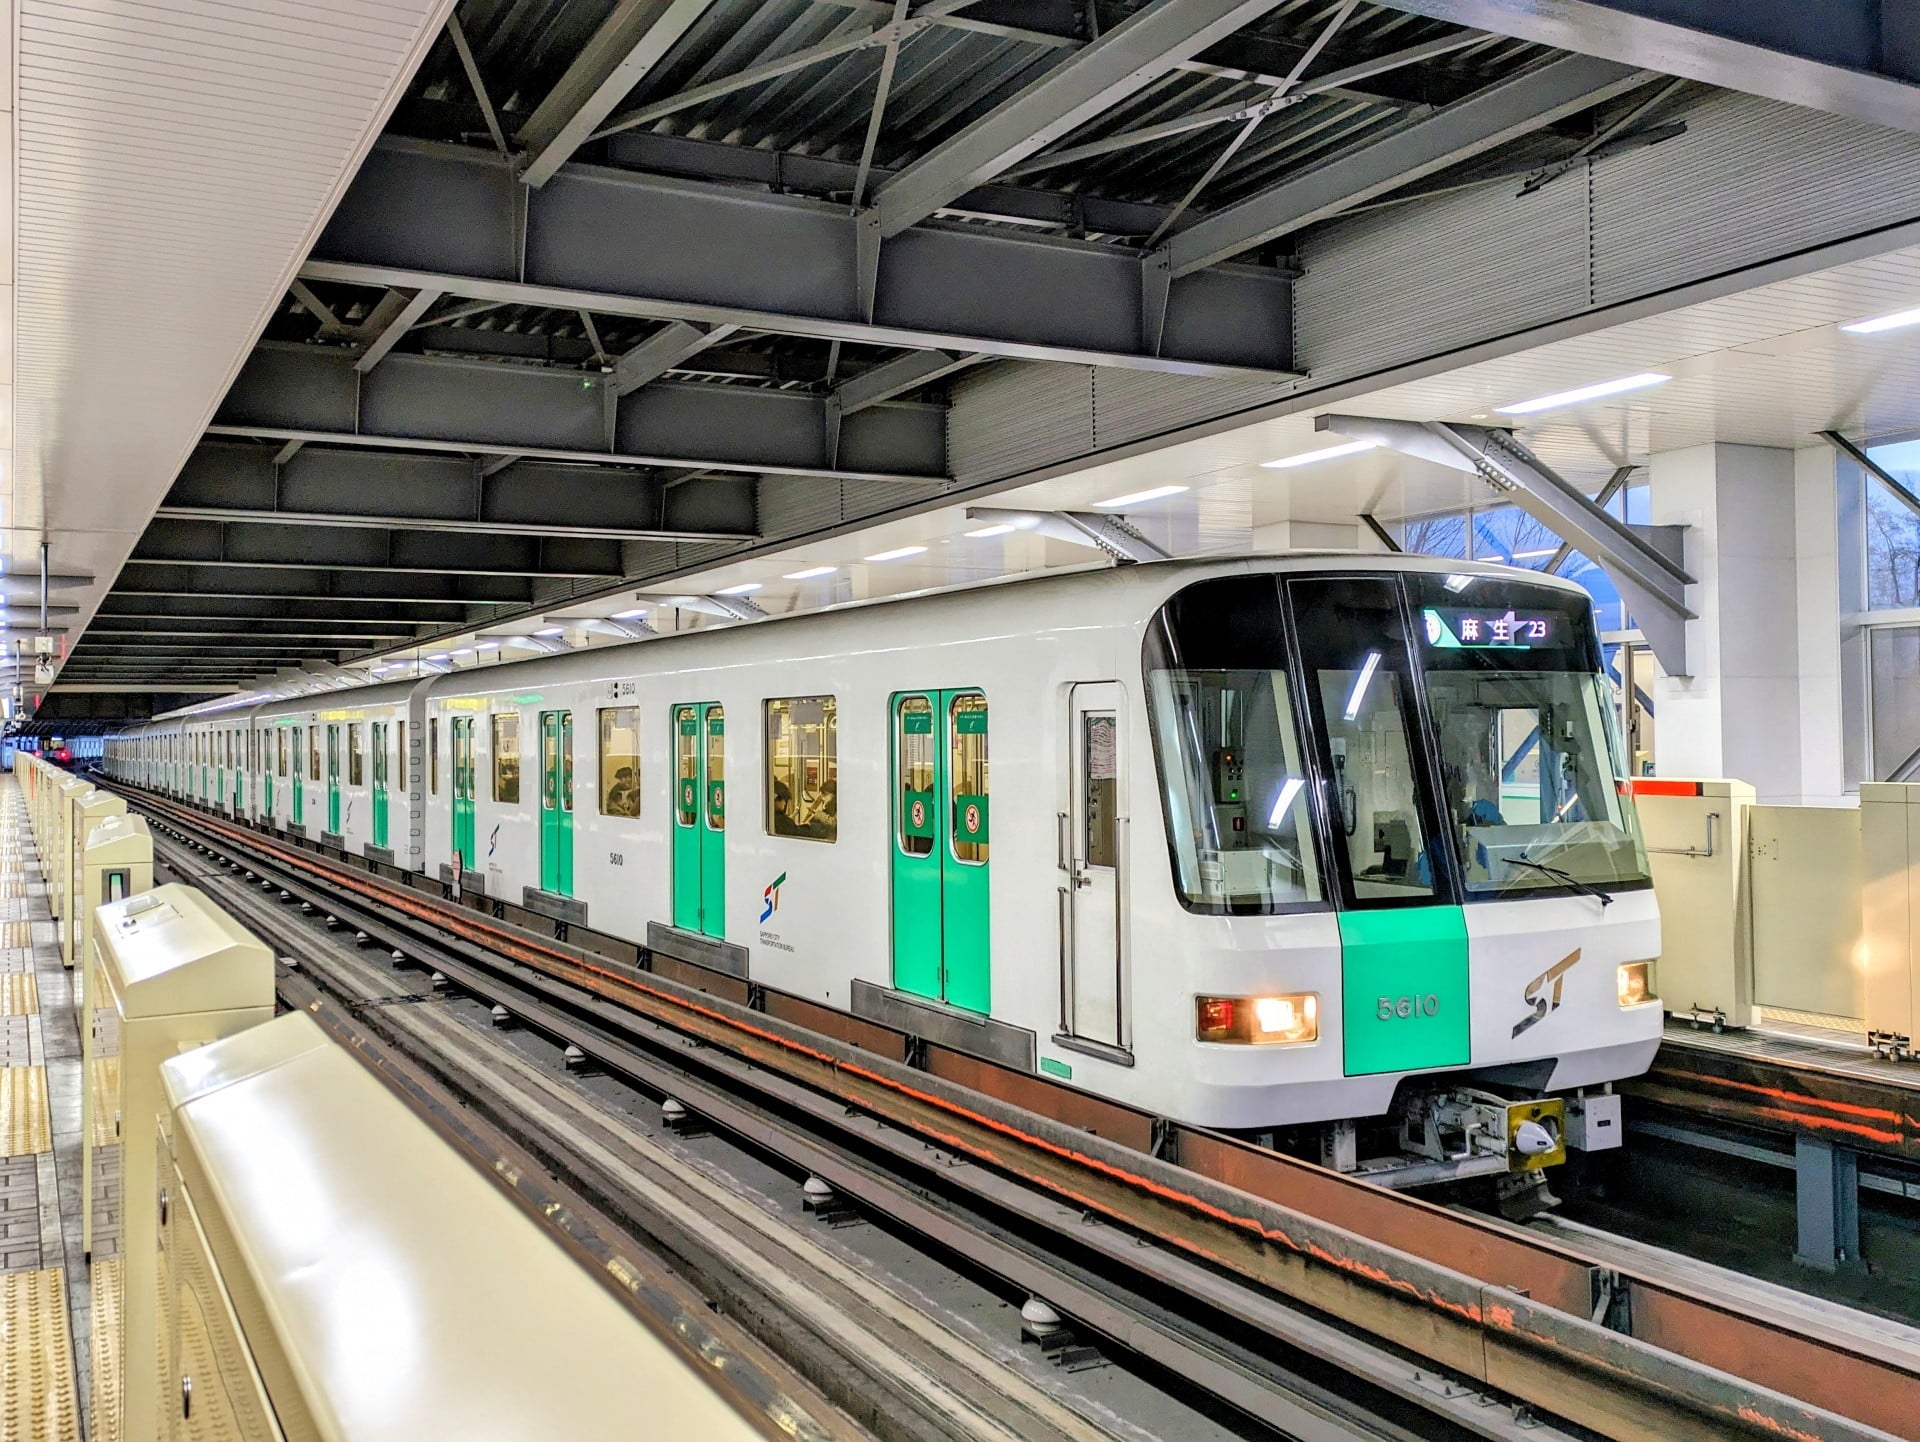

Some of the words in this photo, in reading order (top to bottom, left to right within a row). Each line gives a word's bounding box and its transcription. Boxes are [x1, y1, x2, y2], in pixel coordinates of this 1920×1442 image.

[1461, 618, 1510, 641] 麻生
[1528, 621, 1546, 637] 23
[622, 683, 635, 696] 5610
[610, 853, 623, 866] 5610
[1376, 993, 1440, 1021] 5610
